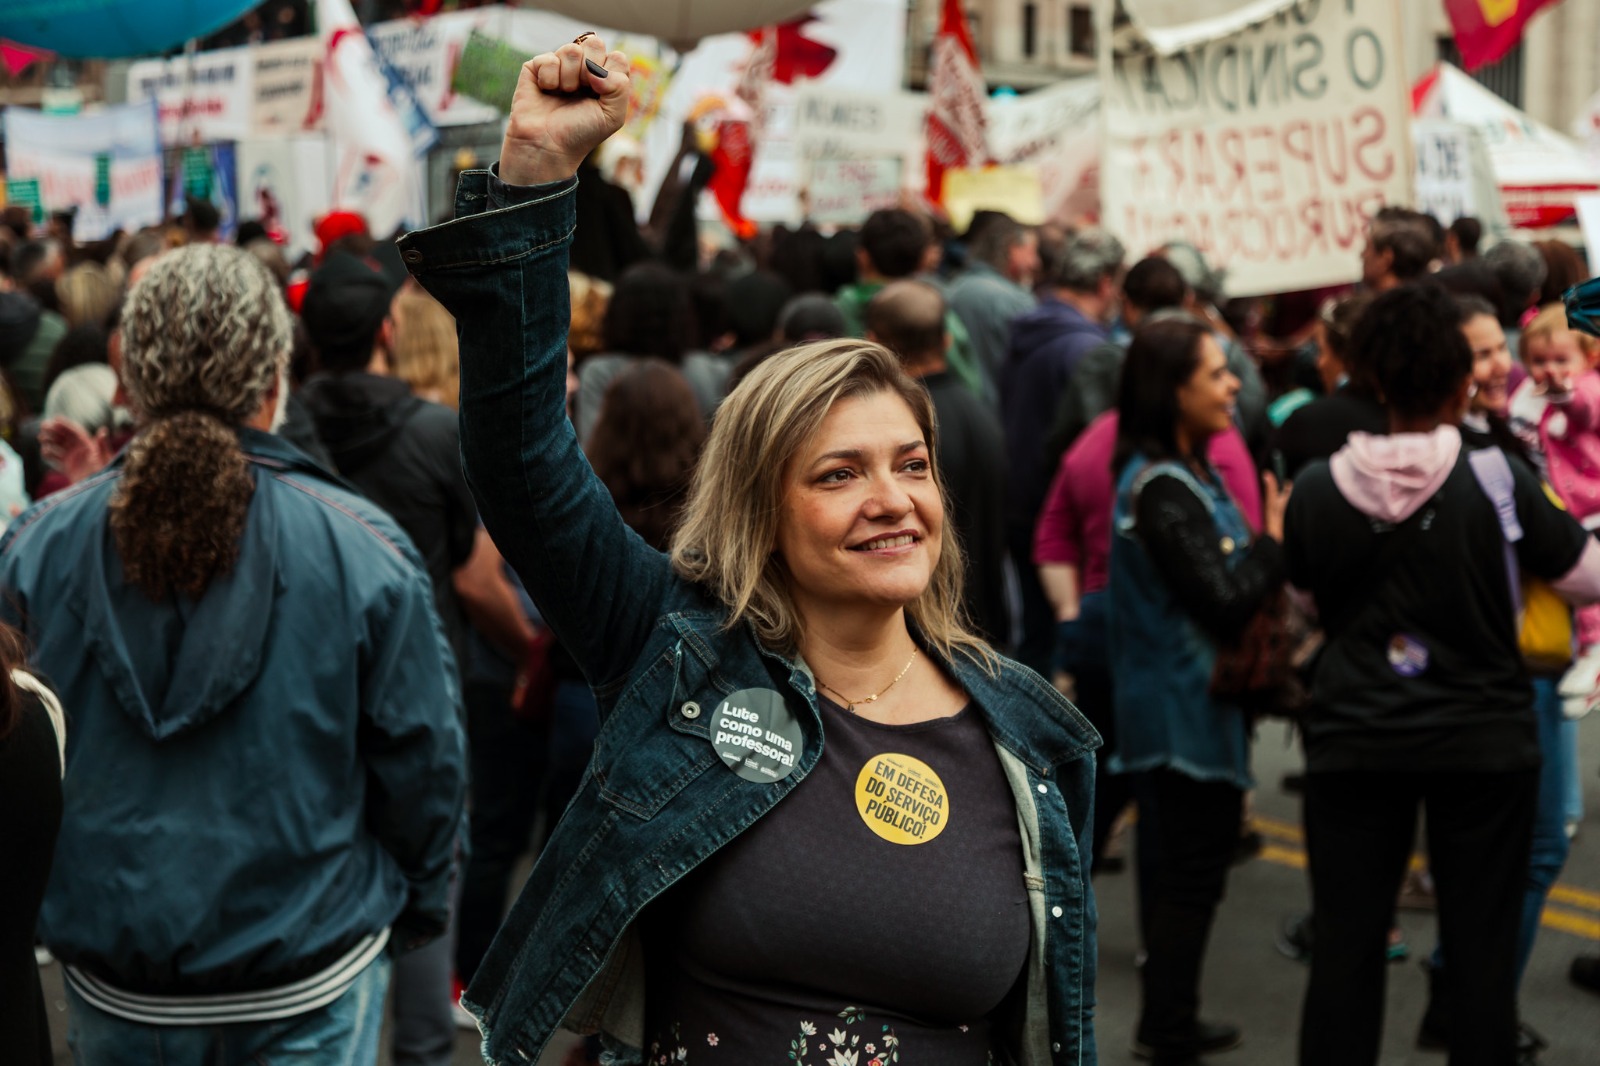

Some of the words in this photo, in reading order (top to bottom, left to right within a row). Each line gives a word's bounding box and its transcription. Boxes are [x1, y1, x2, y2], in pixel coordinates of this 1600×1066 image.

[722, 702, 759, 723] Lute
[715, 730, 795, 767] professora!
[719, 717, 762, 738] como
[765, 730, 793, 752] uma
[865, 776, 886, 797] DO
[886, 787, 941, 825] SERVIÇO
[874, 761, 896, 782] EM
[896, 772, 943, 809] DEFESA
[865, 799, 927, 839] PÚBLICO!
